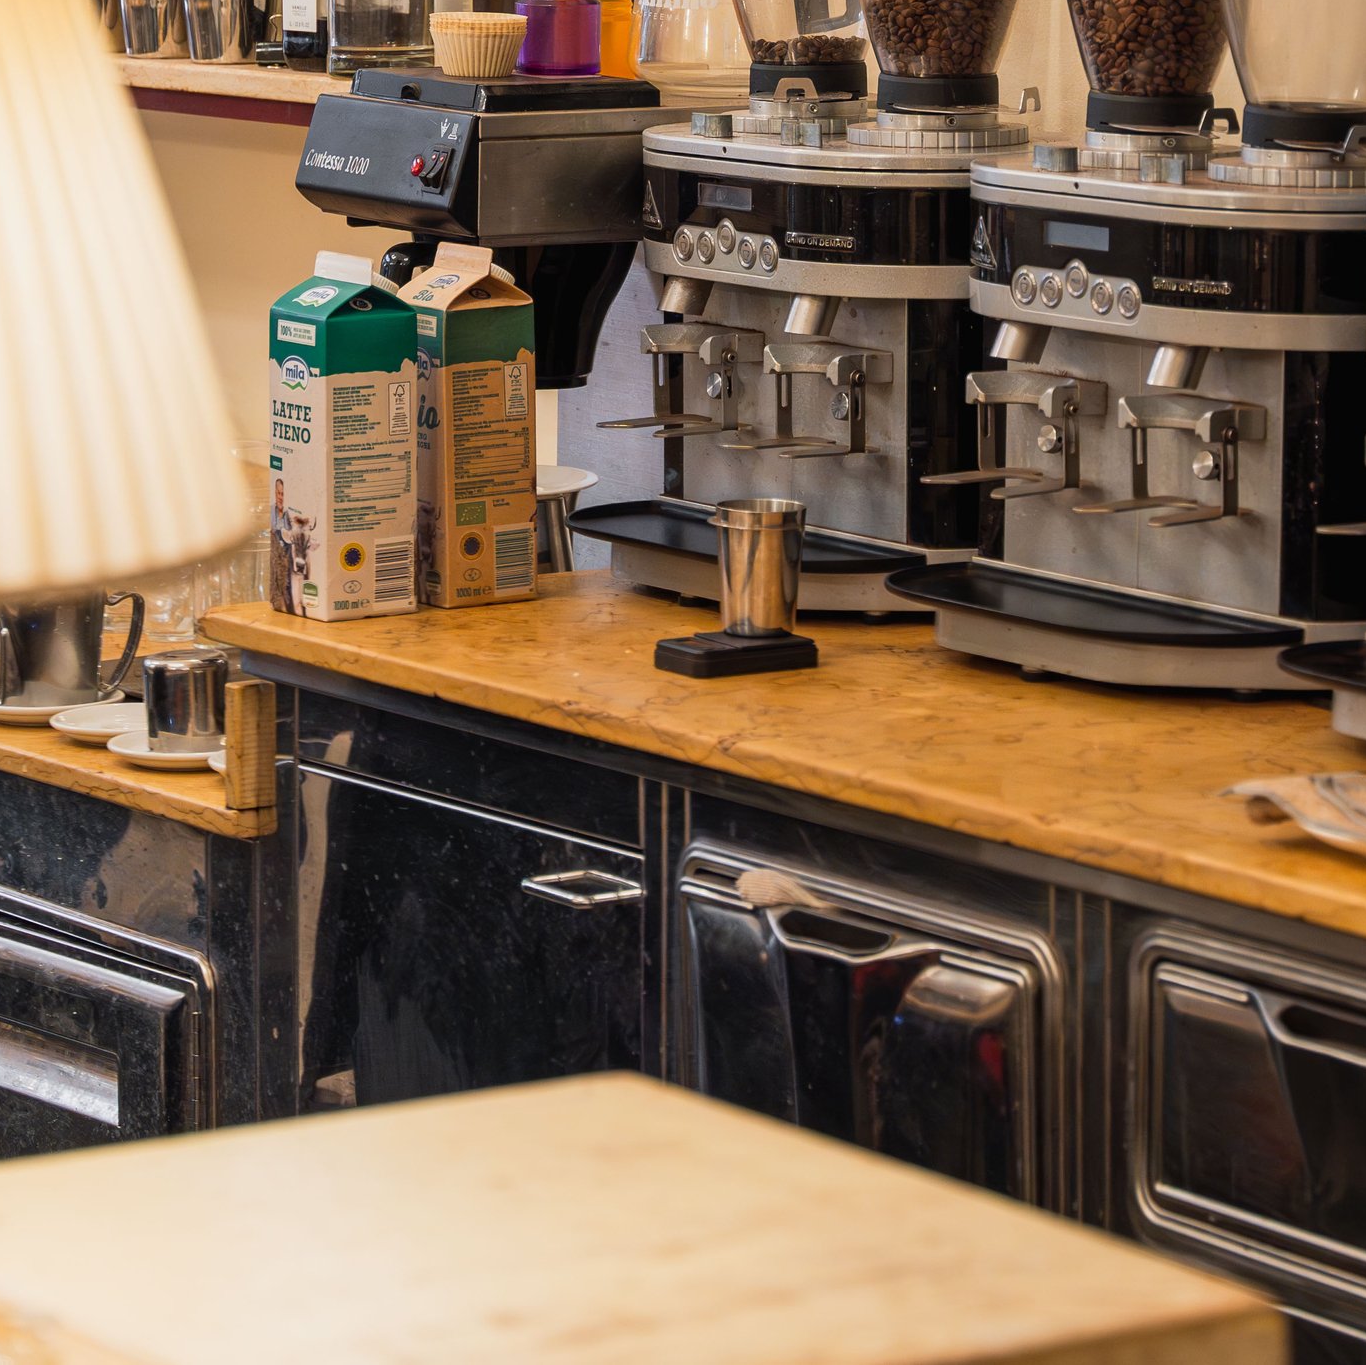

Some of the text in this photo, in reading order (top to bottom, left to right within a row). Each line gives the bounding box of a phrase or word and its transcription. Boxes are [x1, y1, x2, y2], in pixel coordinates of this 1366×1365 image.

[305, 149, 370, 175] Contessa 1000
[807, 237, 817, 245] ON
[819, 238, 853, 248] DEMAND
[307, 289, 331, 300] mila
[413, 290, 435, 302] Bio
[1194, 284, 1231, 295] DEMAND
[285, 365, 305, 381] mila
[273, 400, 312, 423] LATTE
[417, 394, 441, 430] io
[273, 422, 311, 444] FIENO
